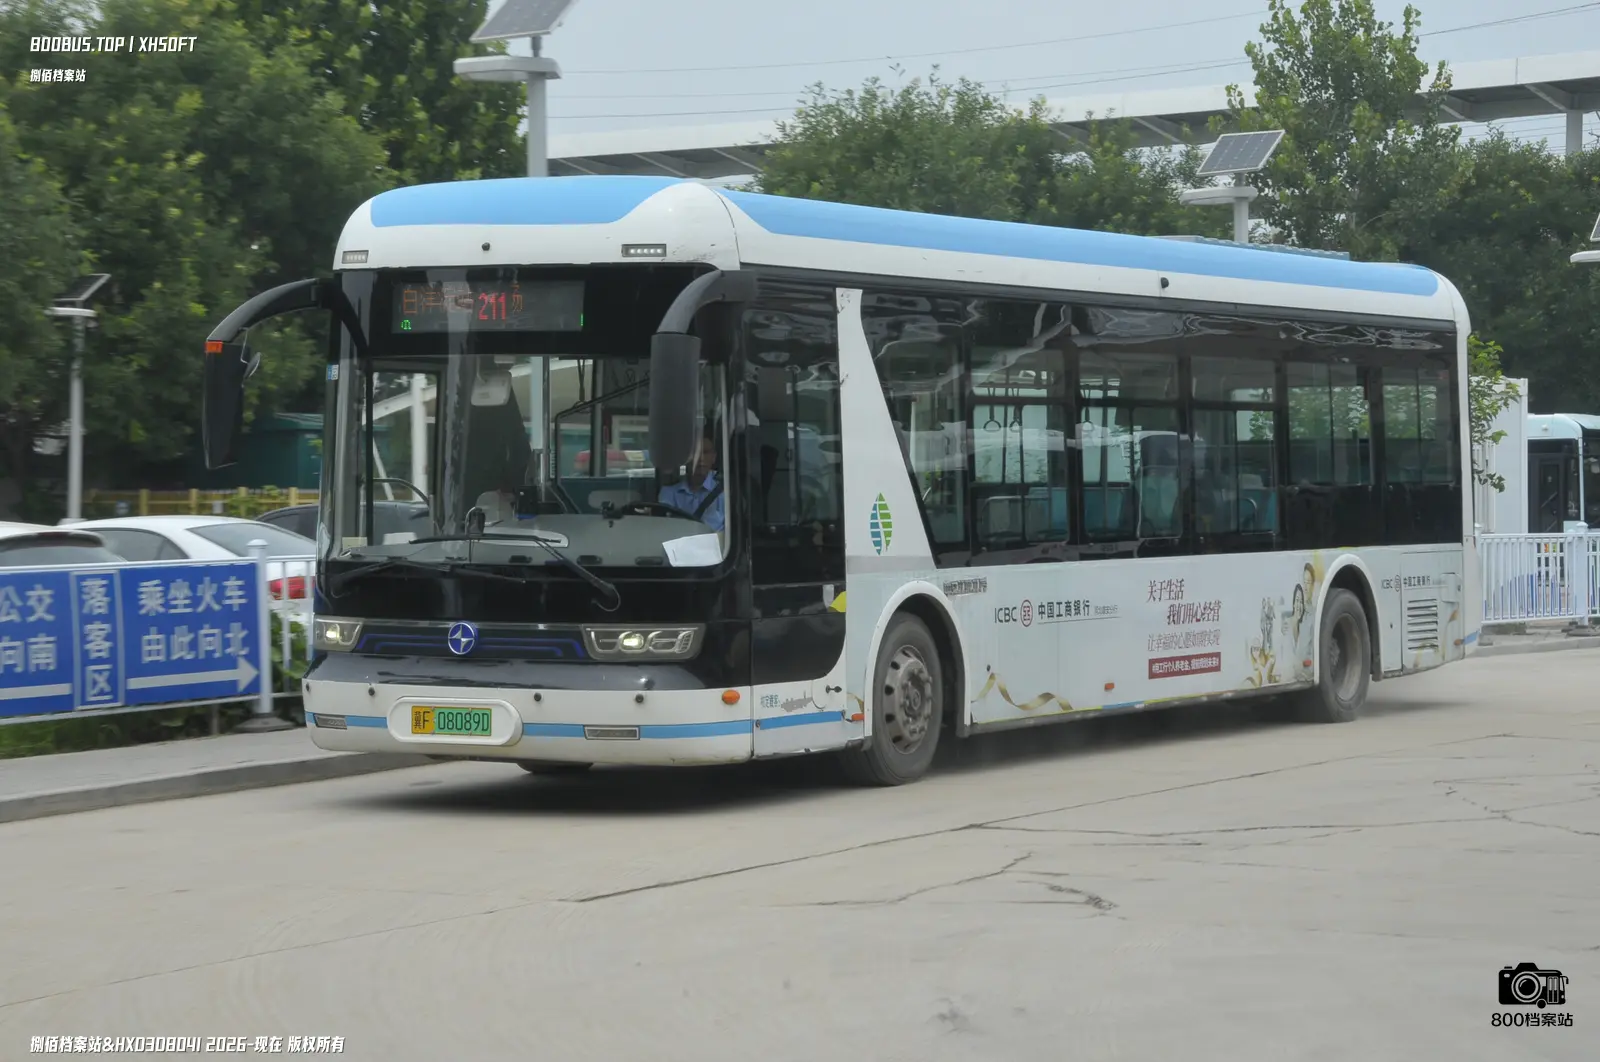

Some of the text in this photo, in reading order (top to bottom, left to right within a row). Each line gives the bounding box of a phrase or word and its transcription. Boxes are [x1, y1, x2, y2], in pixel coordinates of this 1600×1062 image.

[478, 292, 507, 320] 211
[0, 584, 55, 623] 公交
[138, 576, 248, 616] 乘坐火车
[1146, 578, 1185, 603] 关于生活
[994, 606, 1017, 624] ICBC
[1038, 600, 1090, 620] 中国工商银行
[1167, 600, 1222, 625] 我们用心经营
[0, 632, 57, 674] 向南
[80, 578, 113, 701] 落客区
[141, 622, 250, 664] 由此向北
[438, 711, 490, 732] 08089D
